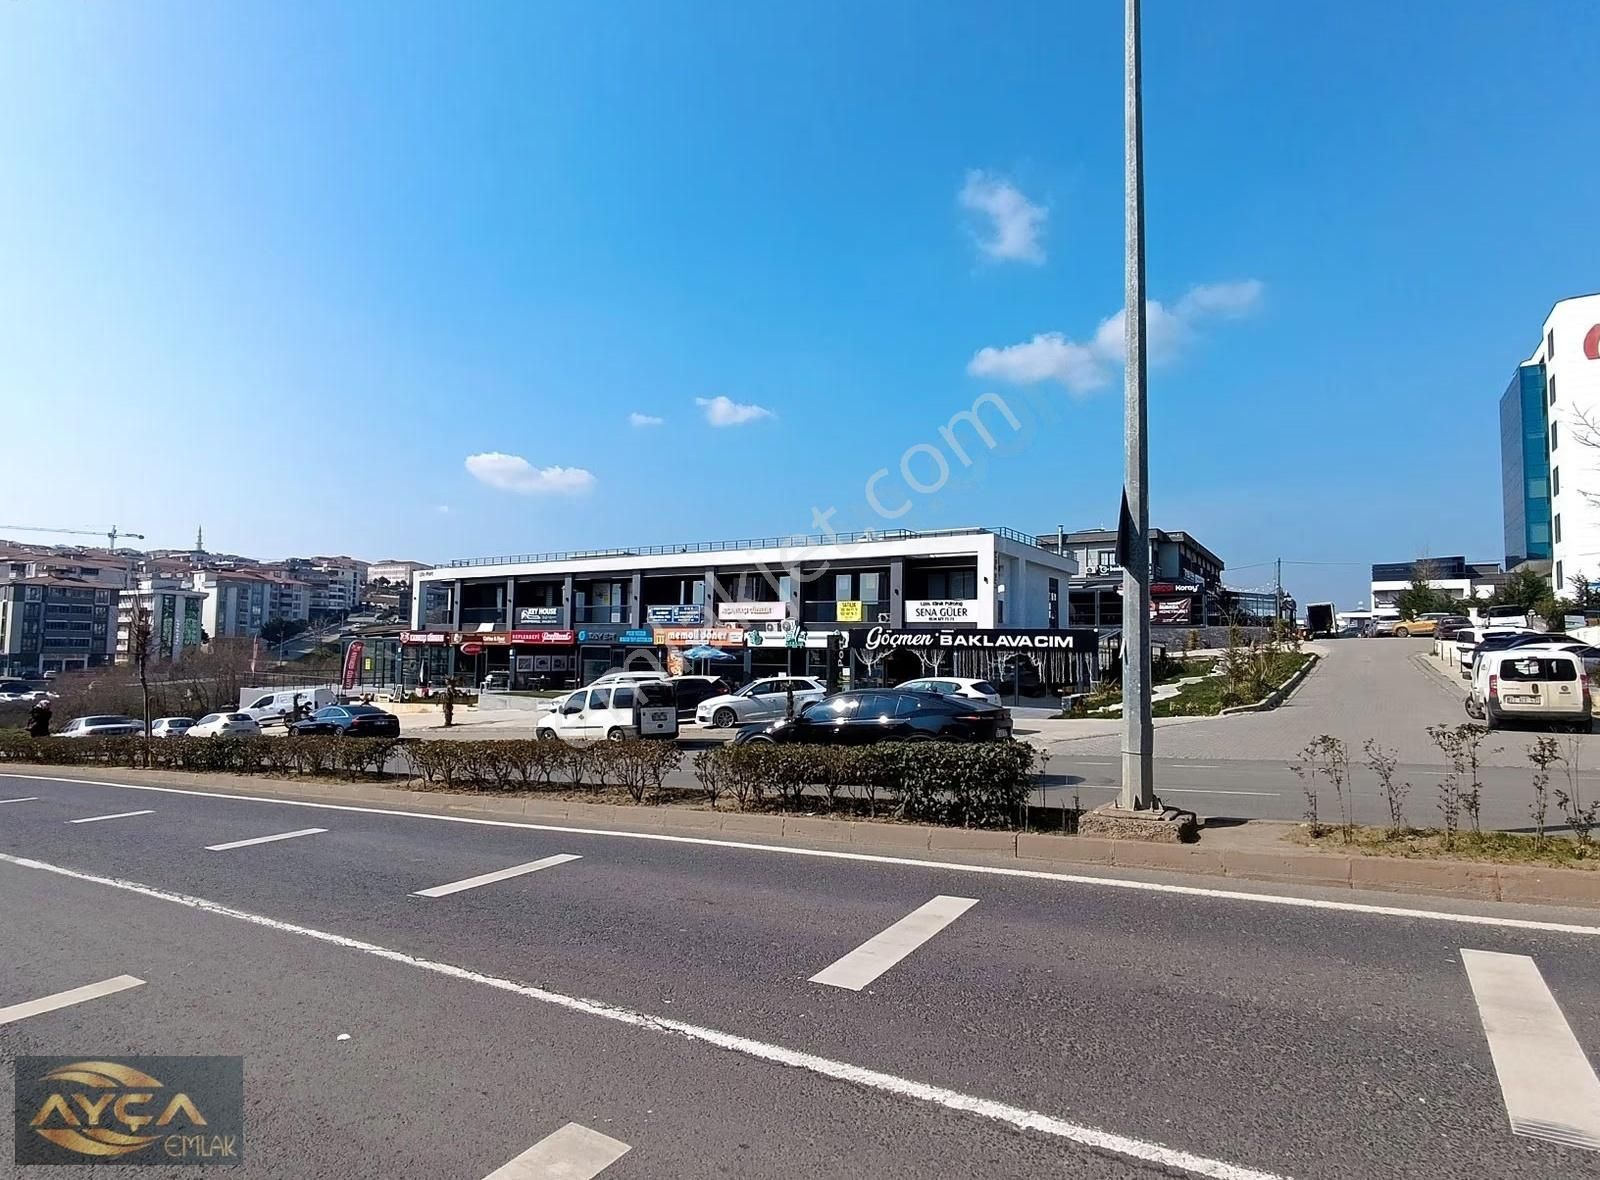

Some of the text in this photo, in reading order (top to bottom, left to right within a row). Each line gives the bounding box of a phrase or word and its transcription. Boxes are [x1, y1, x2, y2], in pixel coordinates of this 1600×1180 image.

[915, 606, 968, 617] SENA GÜLER
[866, 626, 1074, 650] Göçmen BAKLAVACIM
